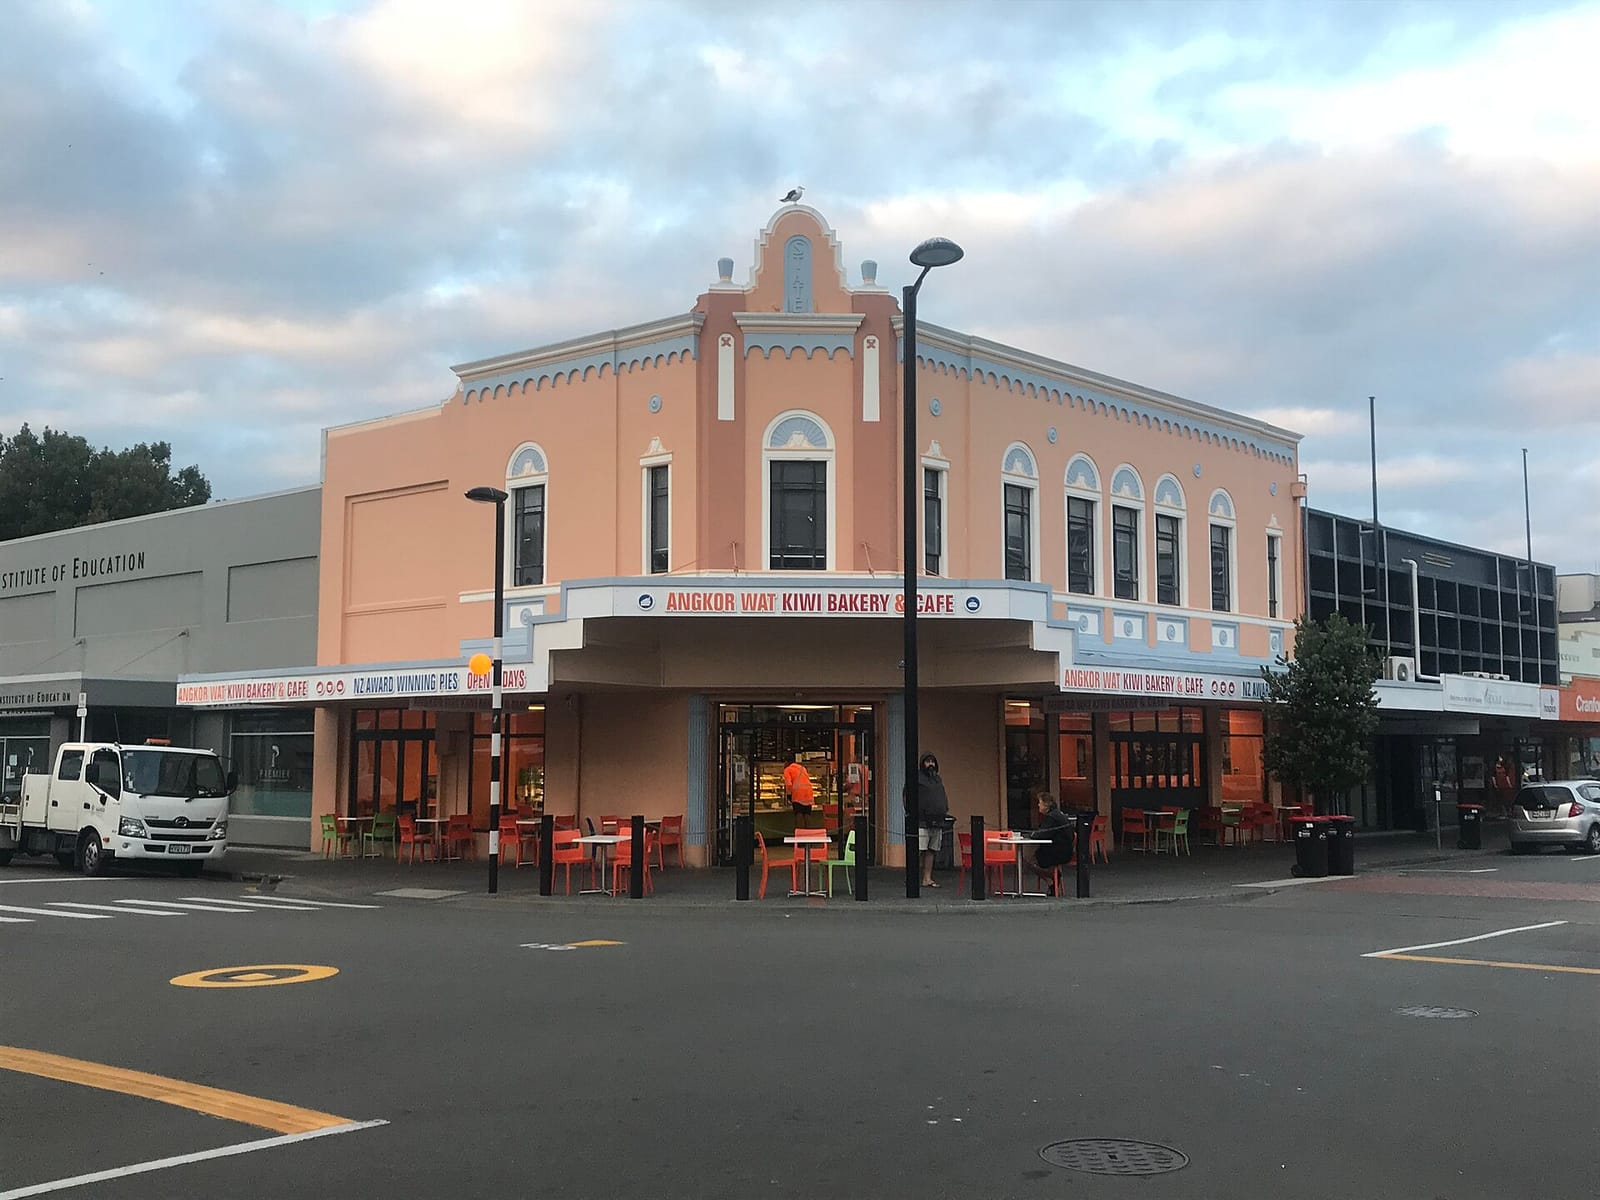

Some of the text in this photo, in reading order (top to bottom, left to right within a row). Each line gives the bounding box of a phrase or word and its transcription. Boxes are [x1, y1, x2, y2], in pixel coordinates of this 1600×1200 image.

[1, 551, 145, 589] STITUTE OF EDUCATION
[666, 592, 954, 613] ANGKOR WAT KIWI BAKERY & CAFE
[353, 673, 458, 694] NZ AWARD WINNING PIES
[467, 670, 526, 689] OPEN DAYS
[1064, 669, 1204, 694] ANGKOR WAT KIWI BAKERY & CAFE
[1242, 681, 1270, 698] NZ AWAR
[37, 691, 71, 703] EDUCATON
[178, 680, 307, 703] ANGKOR WAT KIWI BAKERY & CAFE
